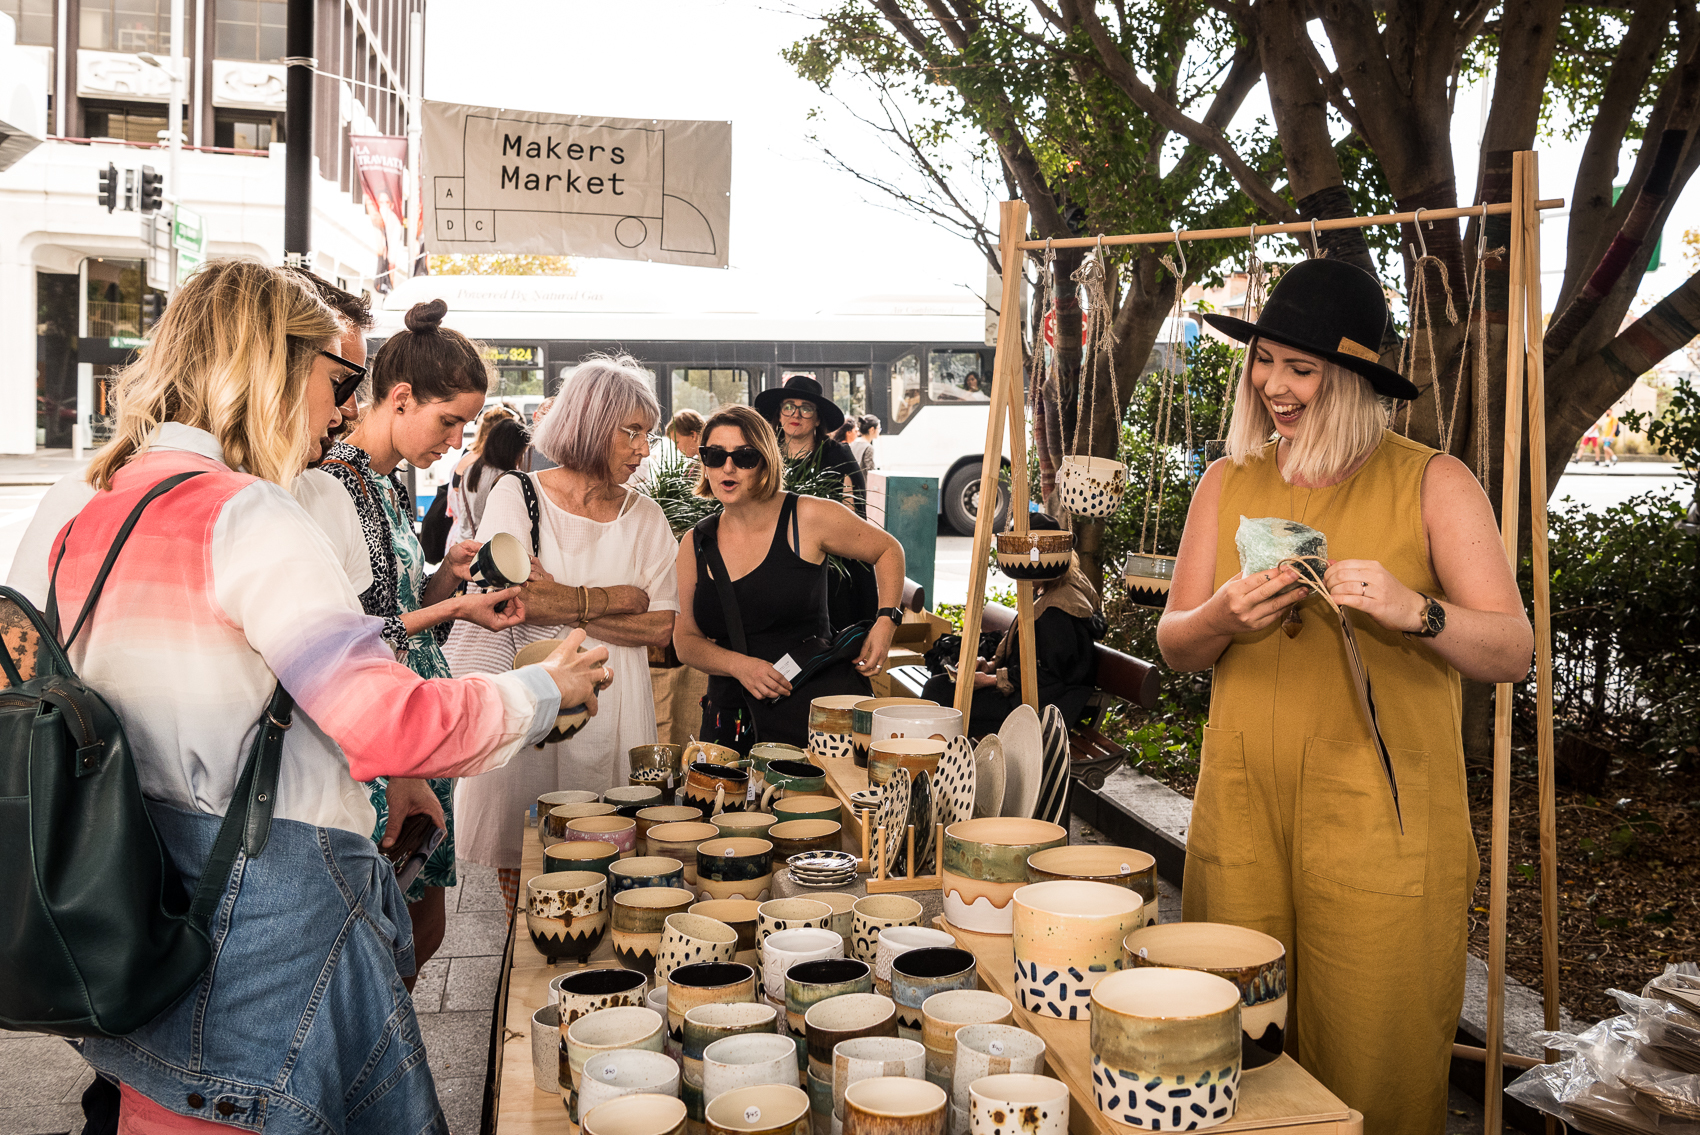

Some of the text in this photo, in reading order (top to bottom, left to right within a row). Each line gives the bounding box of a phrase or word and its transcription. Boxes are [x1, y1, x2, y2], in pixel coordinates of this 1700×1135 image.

[356, 145, 370, 155] LA
[502, 133, 625, 164] Makers
[501, 165, 625, 196] Market
[445, 188, 453, 198] A
[446, 220, 483, 231] D C
[457, 288, 605, 302] Powered By Natural Gas
[509, 347, 533, 361] 324
